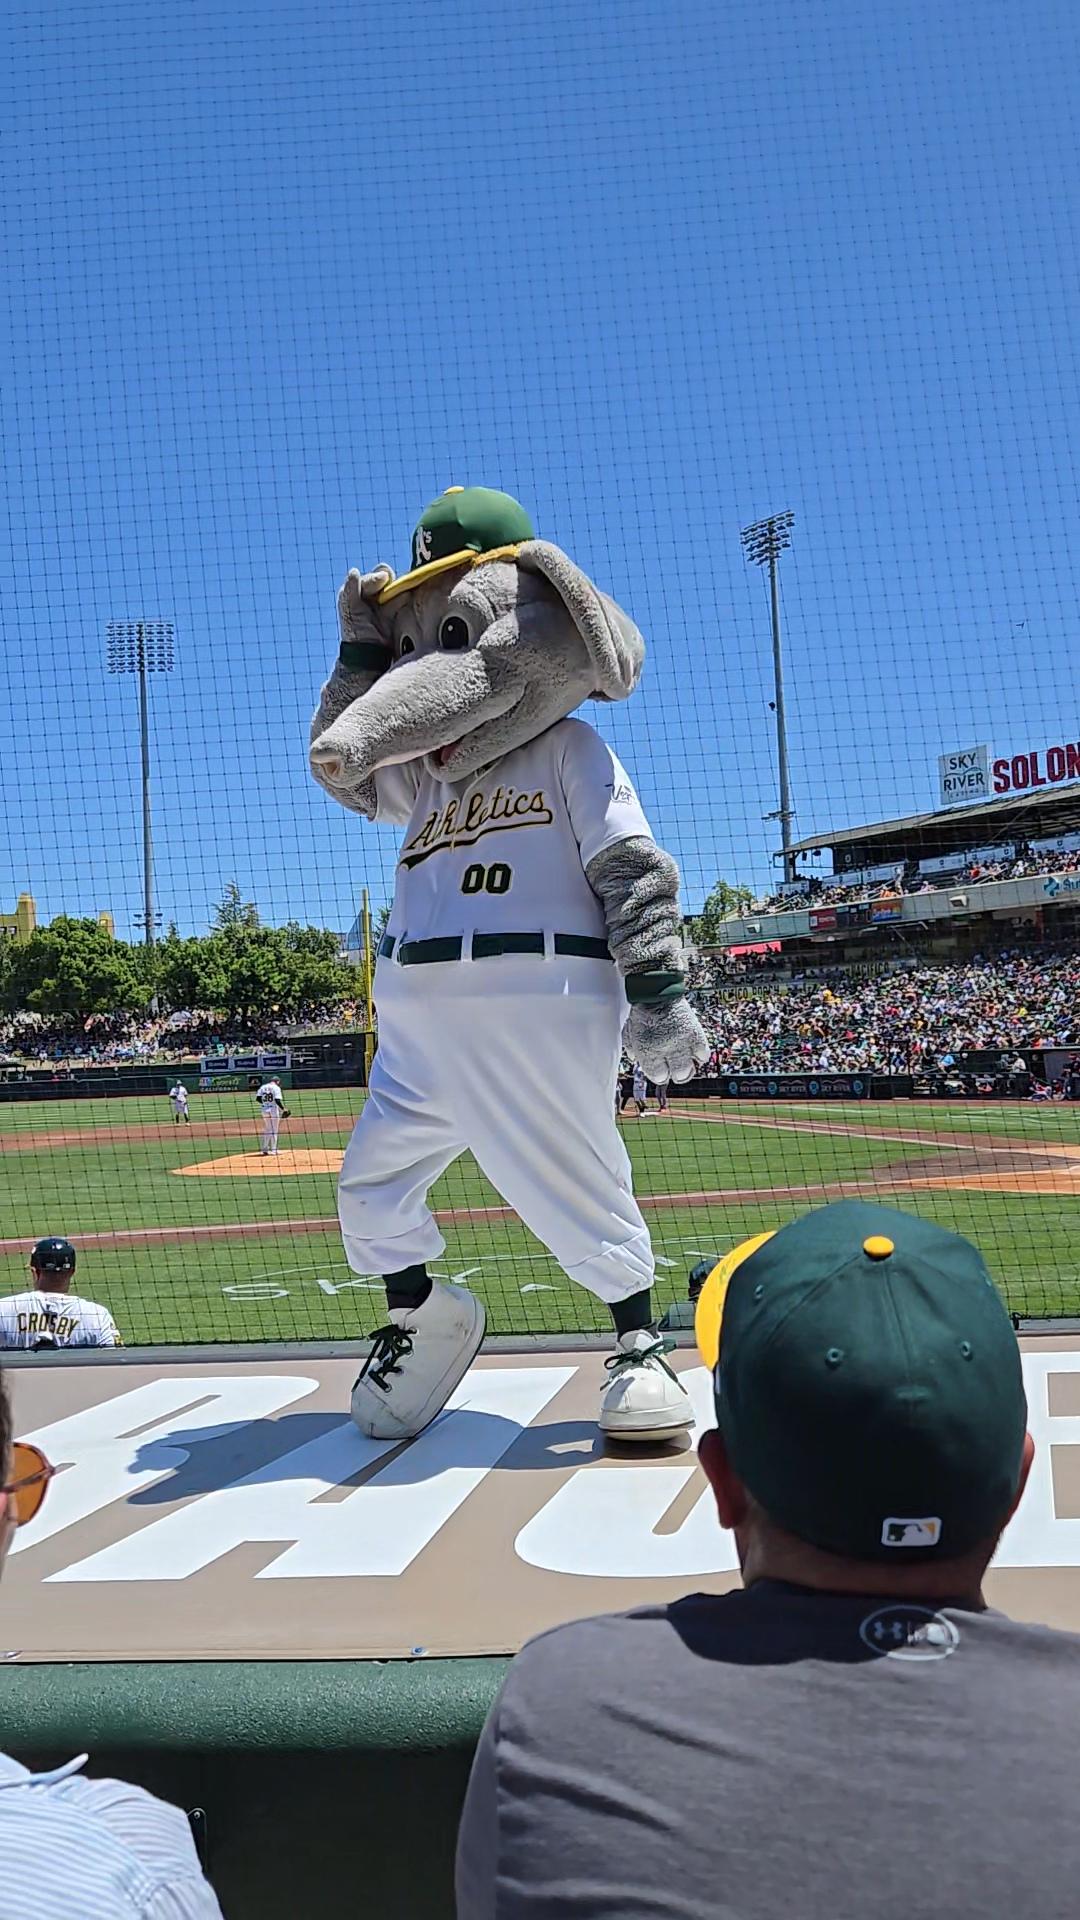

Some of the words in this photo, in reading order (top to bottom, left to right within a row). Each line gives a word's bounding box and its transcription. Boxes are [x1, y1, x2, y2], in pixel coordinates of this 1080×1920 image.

[949, 752, 976, 770] SKY
[943, 771, 985, 791] RIVER
[404, 784, 552, 851] Athletics
[461, 862, 513, 895] 00
[17, 1312, 80, 1338] CROSBY
